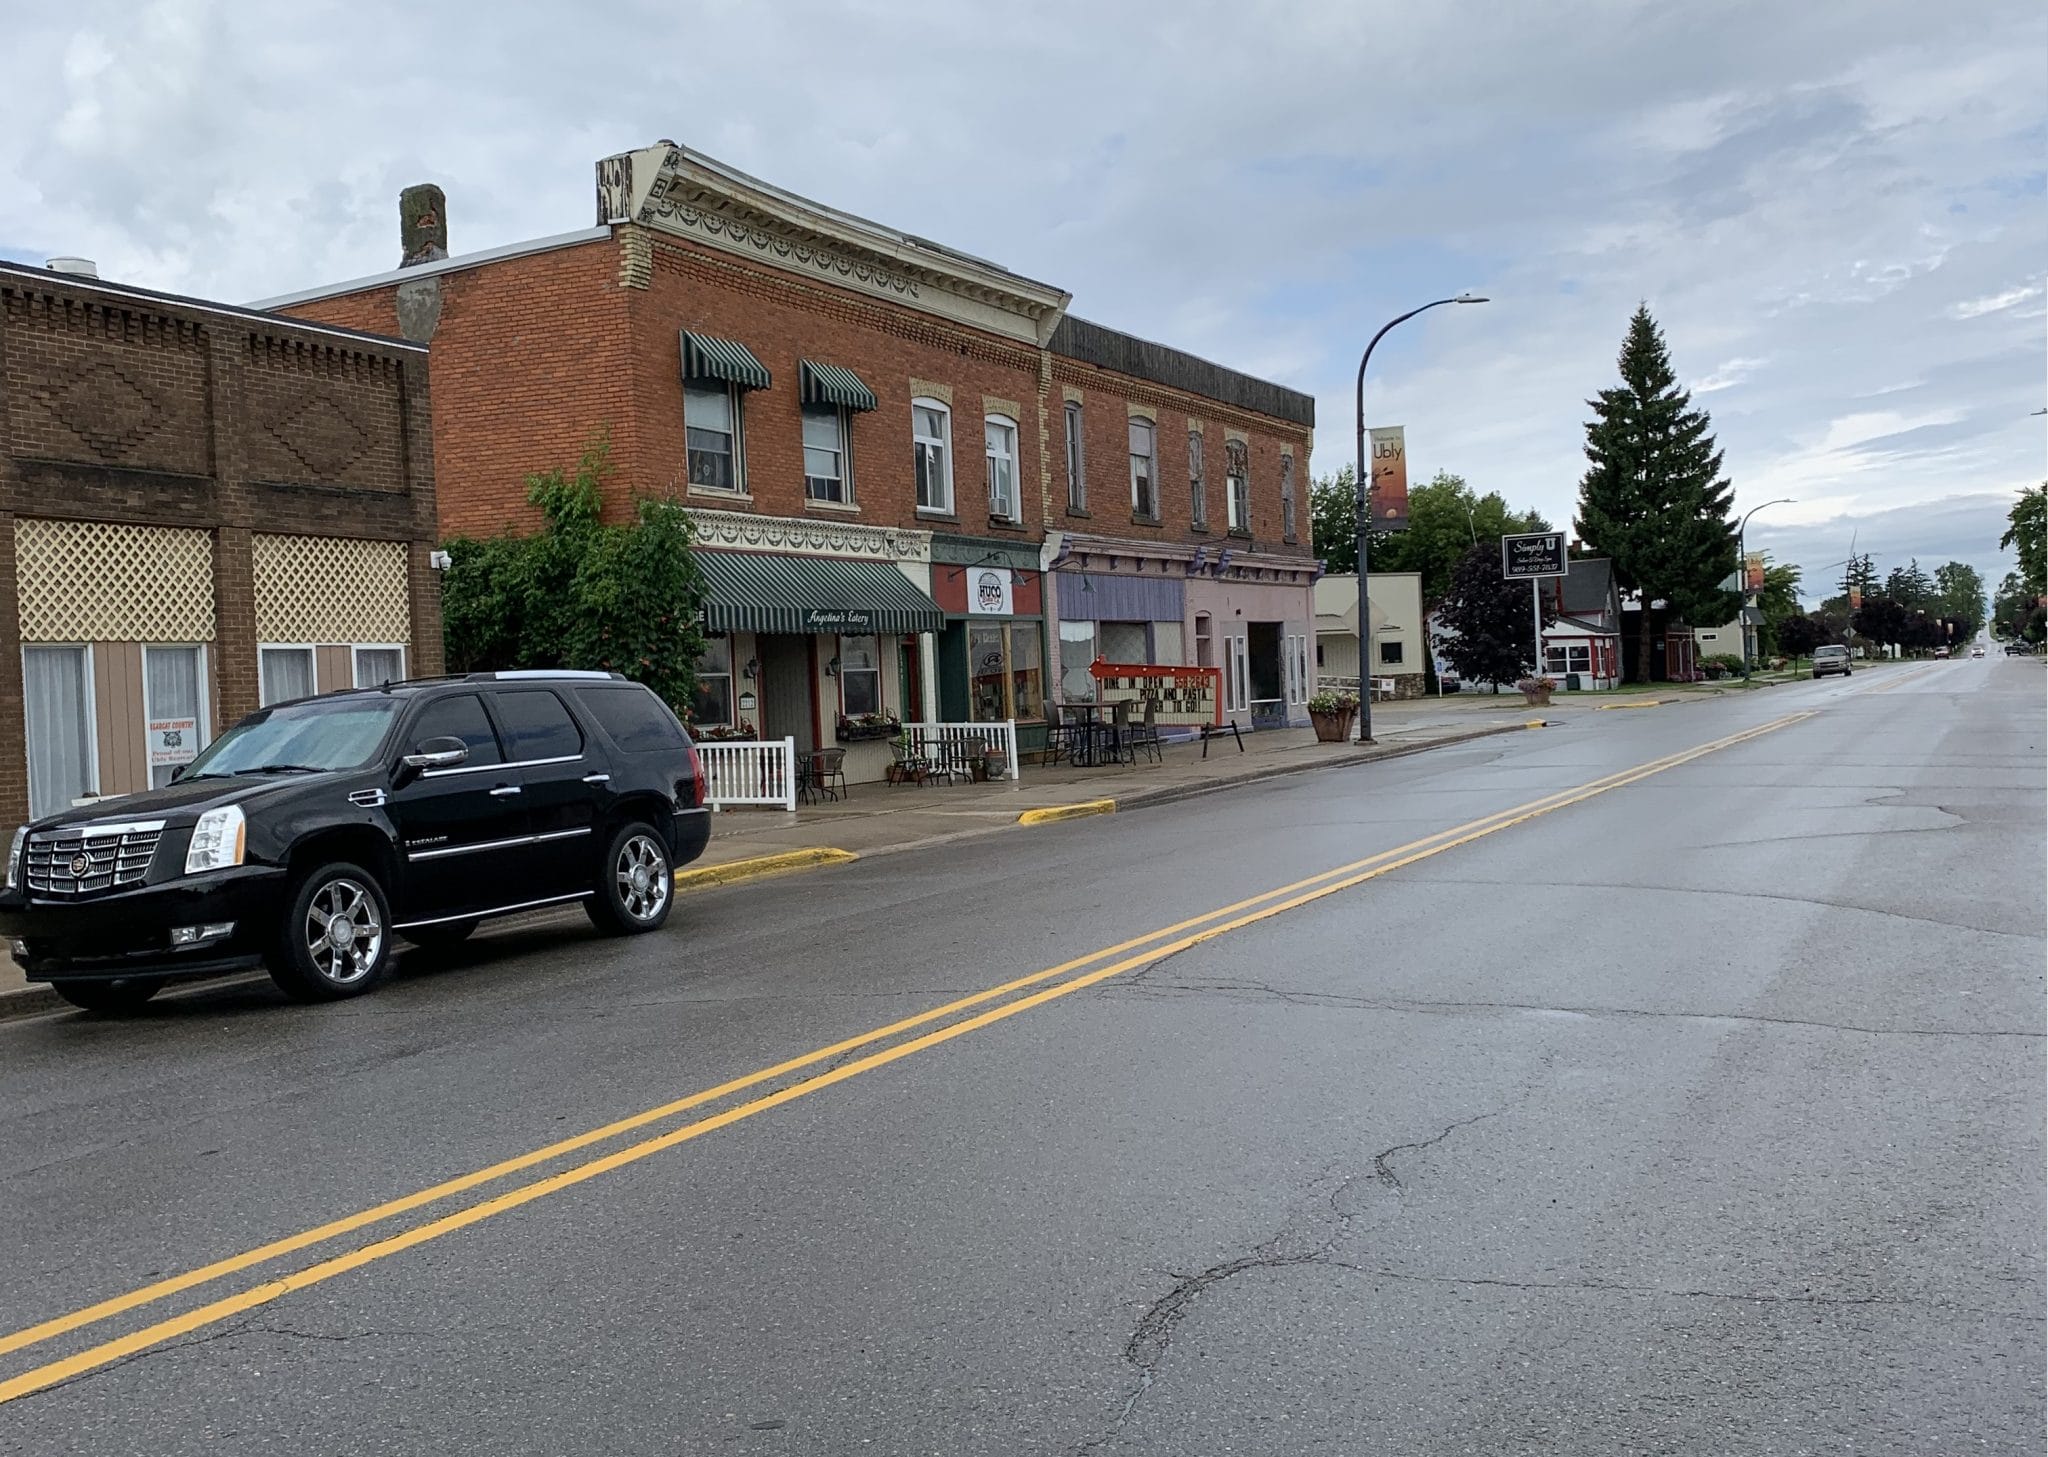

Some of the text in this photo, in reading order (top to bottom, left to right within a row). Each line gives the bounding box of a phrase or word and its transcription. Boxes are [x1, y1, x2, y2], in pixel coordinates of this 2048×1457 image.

[1373, 443, 1402, 460] Ubly
[1513, 537, 1556, 556] Simply U
[980, 585, 1001, 598] HUCO
[807, 610, 869, 626] Angelina's Eatery
[1104, 677, 1119, 689] DINE
[1128, 677, 1135, 689] IN
[1143, 676, 1164, 689] OPEN
[1140, 689, 1207, 700] PIZZA AND PASTA
[1173, 701, 1182, 712] TO
[172, 720, 194, 730] COUNTRY
